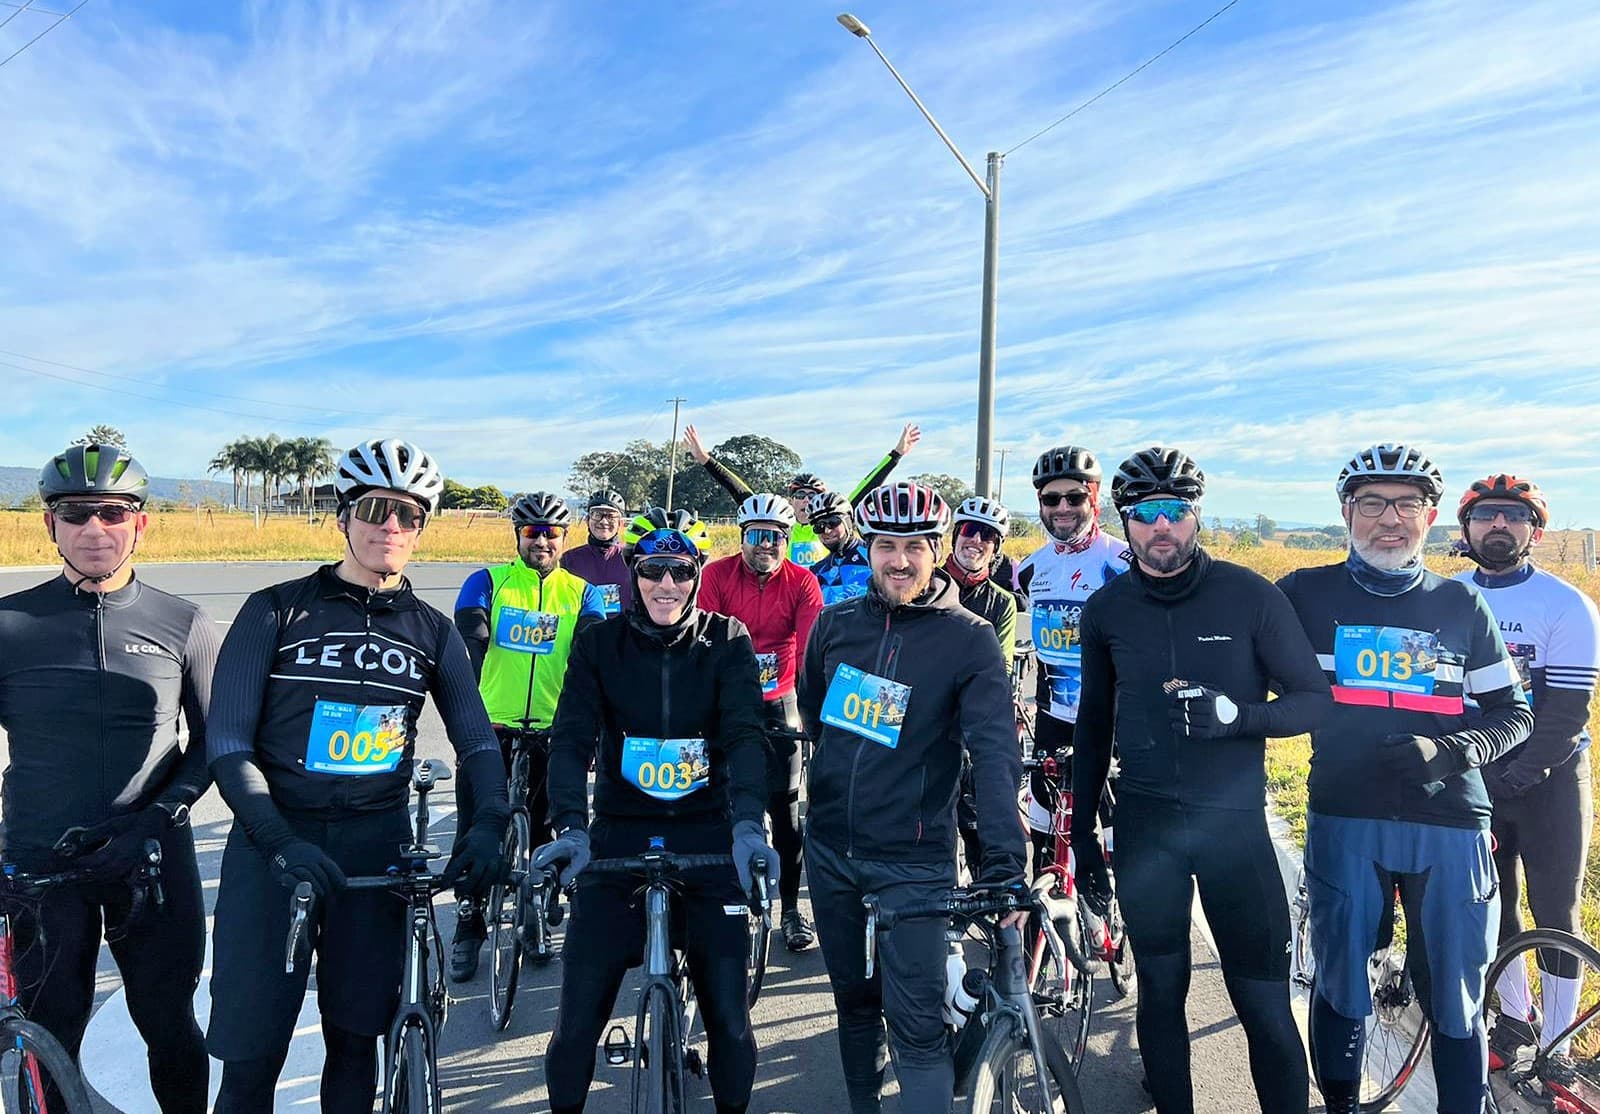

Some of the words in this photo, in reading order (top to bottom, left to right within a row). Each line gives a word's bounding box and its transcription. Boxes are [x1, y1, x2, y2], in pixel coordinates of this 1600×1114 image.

[510, 624, 543, 645] 010
[1041, 627, 1072, 650] 007
[1500, 621, 1523, 633] LIA
[125, 644, 139, 653] LE
[140, 644, 162, 654] COL
[296, 643, 346, 668] LE
[354, 643, 422, 680] COL
[1357, 649, 1412, 680] 013
[843, 692, 881, 728] 011
[328, 730, 391, 762] 005
[638, 761, 692, 789] 003
